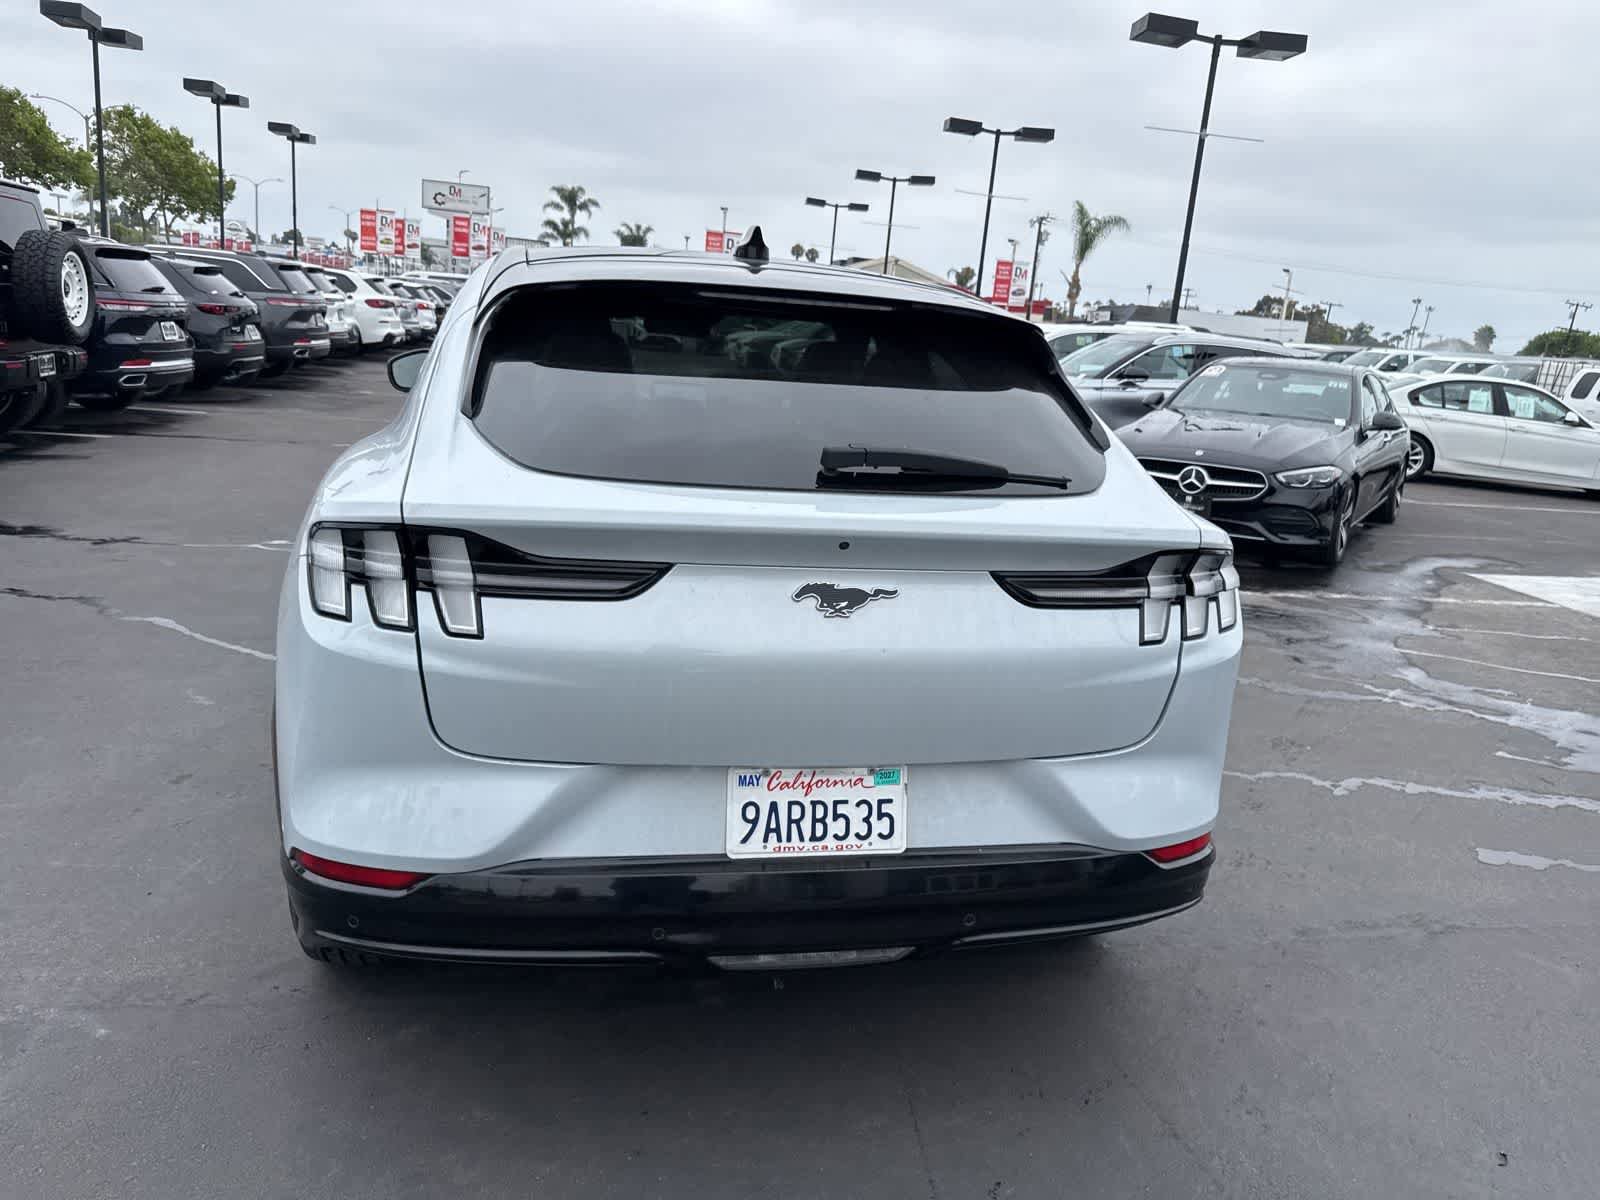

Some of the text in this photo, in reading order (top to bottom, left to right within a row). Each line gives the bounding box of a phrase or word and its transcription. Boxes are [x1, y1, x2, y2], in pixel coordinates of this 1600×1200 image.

[738, 774, 762, 787] MAY
[767, 770, 876, 797] California
[740, 798, 895, 844] 9ARB535
[773, 843, 863, 852] dmv.ca.gov
